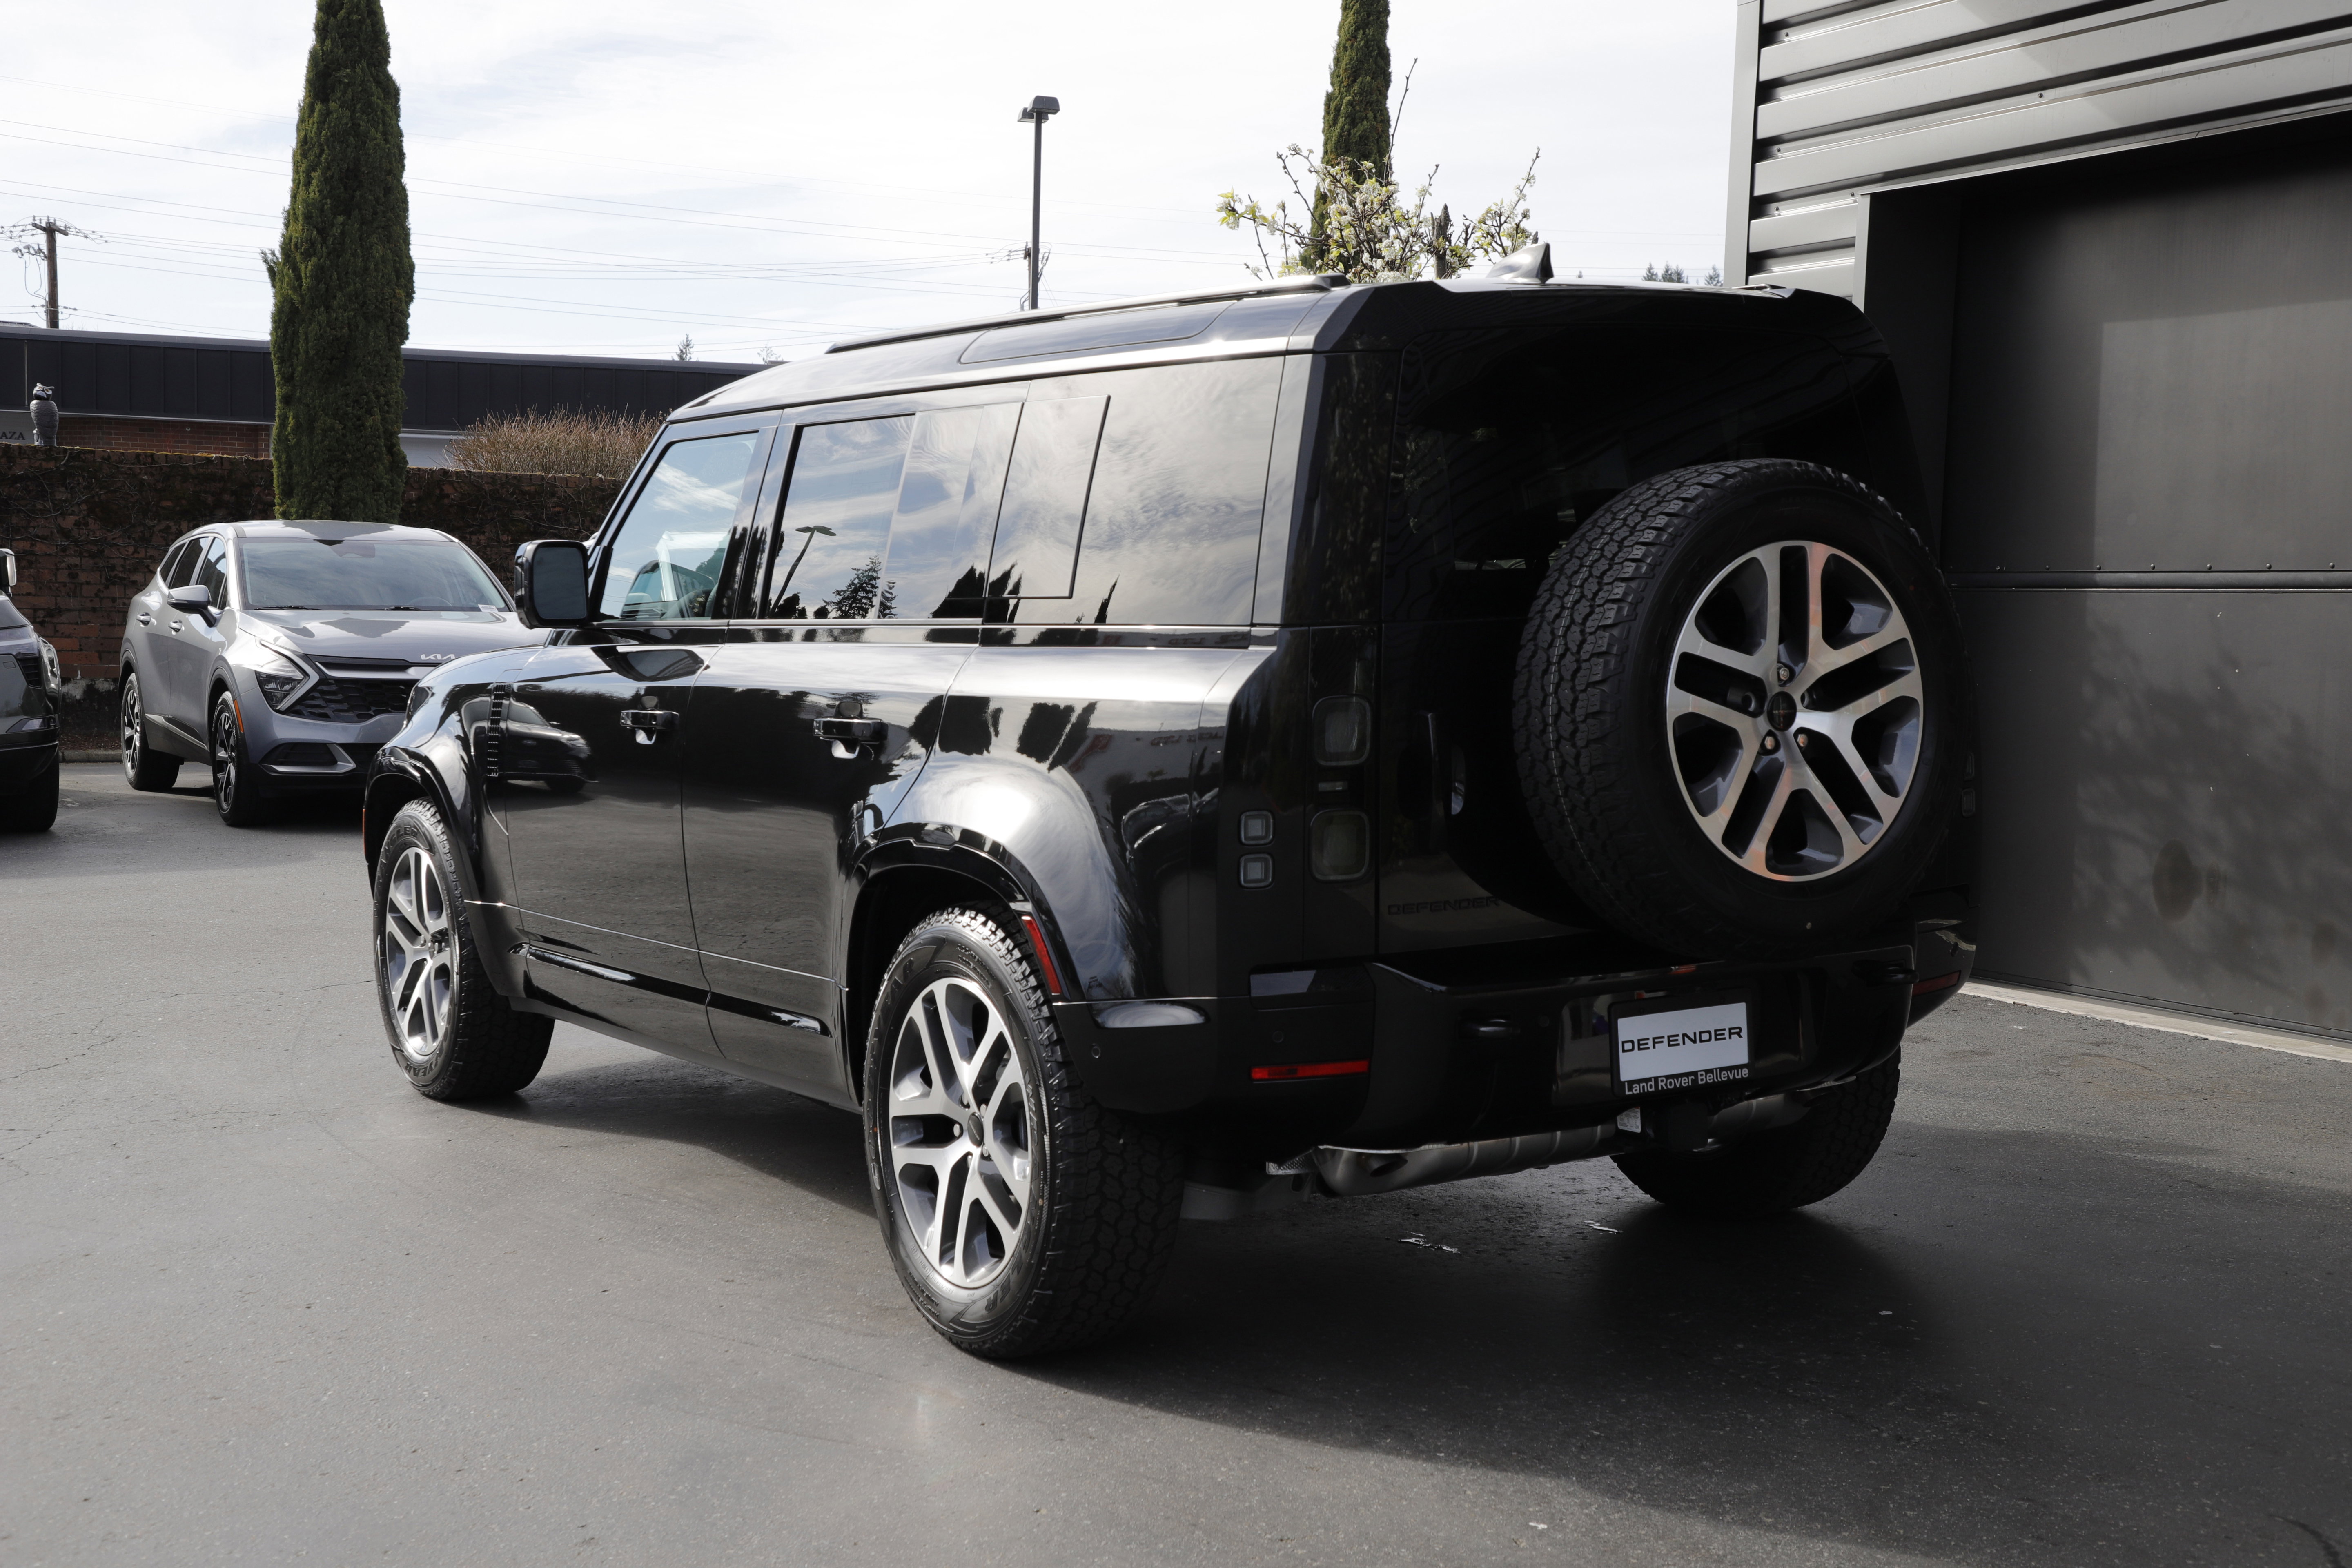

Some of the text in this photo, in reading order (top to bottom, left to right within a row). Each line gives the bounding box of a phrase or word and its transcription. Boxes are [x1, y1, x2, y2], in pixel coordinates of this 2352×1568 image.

[1388, 896, 1500, 915] DEFENDER
[1621, 1026, 1743, 1053] DEFENDER
[1625, 1068, 1748, 1095] Land Rover Bellevue
